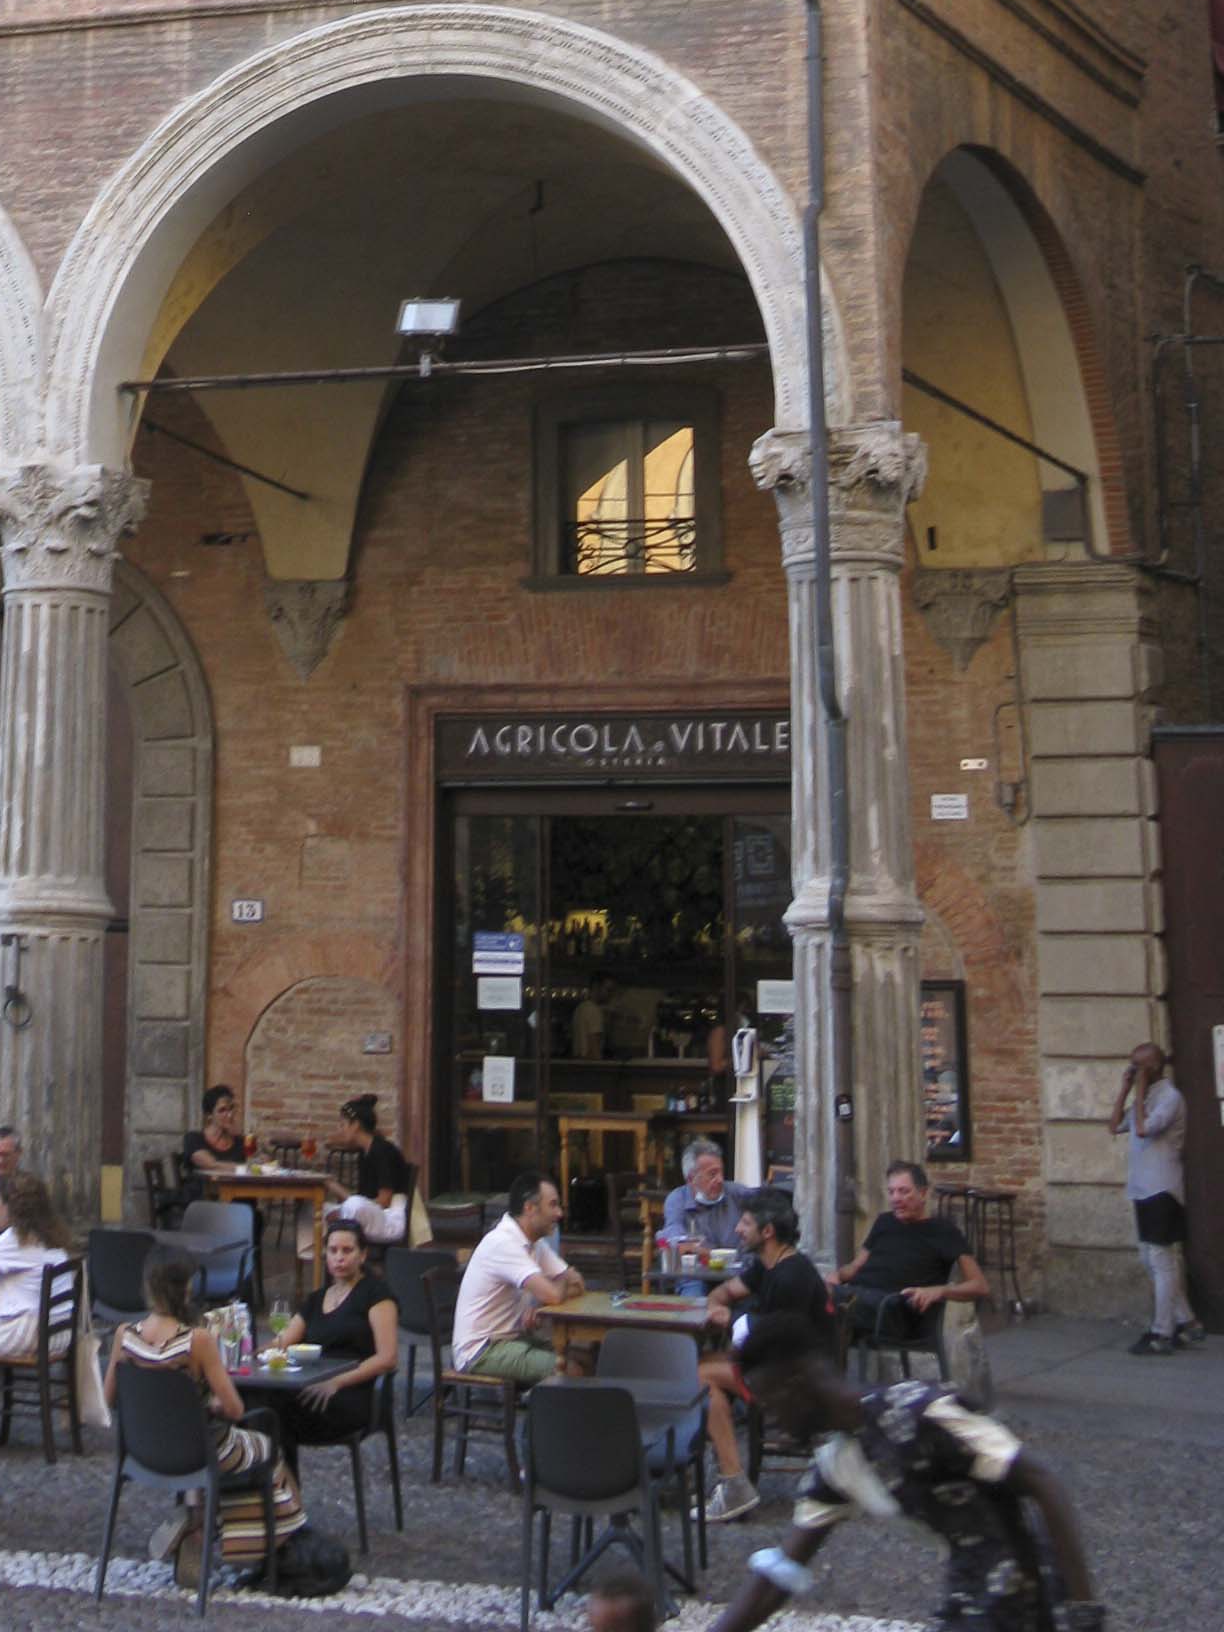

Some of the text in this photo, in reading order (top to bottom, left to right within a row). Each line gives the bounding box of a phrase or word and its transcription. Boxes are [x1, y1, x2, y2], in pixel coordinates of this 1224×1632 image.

[466, 724, 645, 755] AGRICOLA
[670, 721, 790, 753] VITALE
[237, 903, 257, 919] 13
